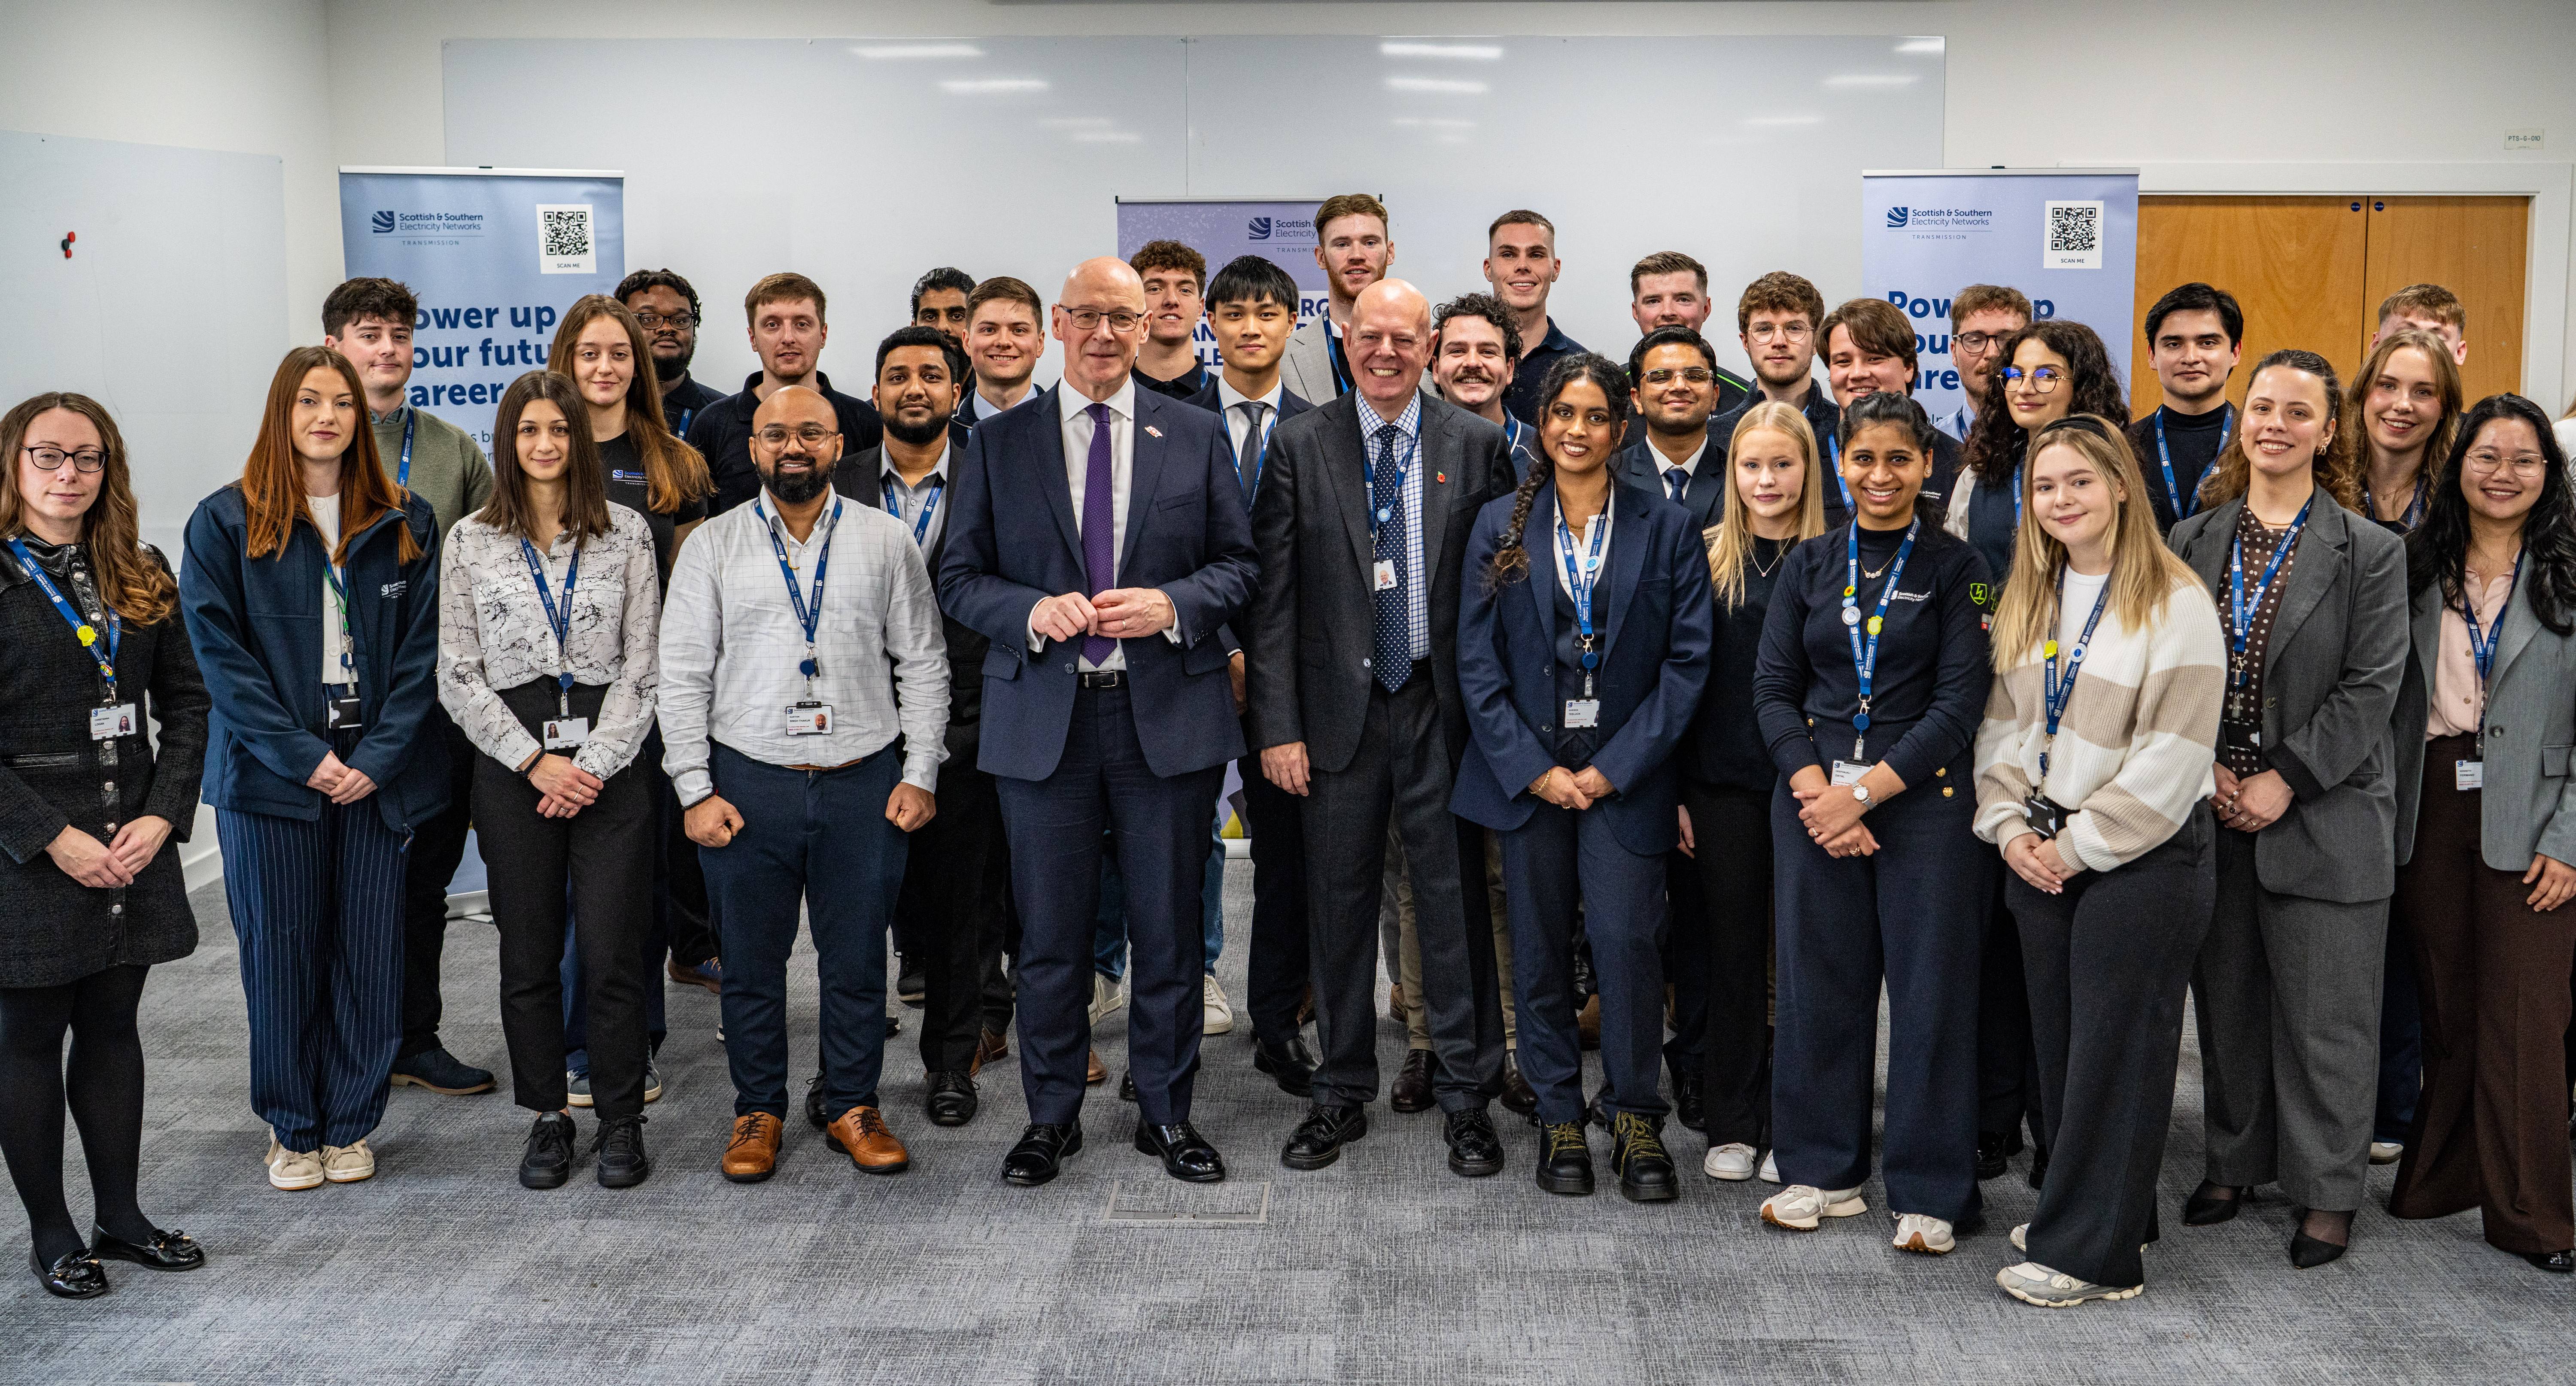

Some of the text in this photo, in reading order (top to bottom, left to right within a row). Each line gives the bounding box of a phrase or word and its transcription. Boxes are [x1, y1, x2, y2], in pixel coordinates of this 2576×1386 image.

[399, 213, 434, 221] Scottish
[444, 213, 483, 221] Southern
[1912, 218, 1949, 227] Electricity
[400, 222, 440, 232] Electricity
[1276, 229, 1316, 239] Electricity
[1888, 291, 1951, 318] Pow
[414, 306, 556, 334] ower up
[412, 338, 554, 368] our futu
[404, 383, 504, 407] areer
[24, 560, 33, 570] Powering
[35, 574, 45, 585] Southern
[38, 573, 57, 595] Electricity Networks
[45, 586, 54, 597] Scottish
